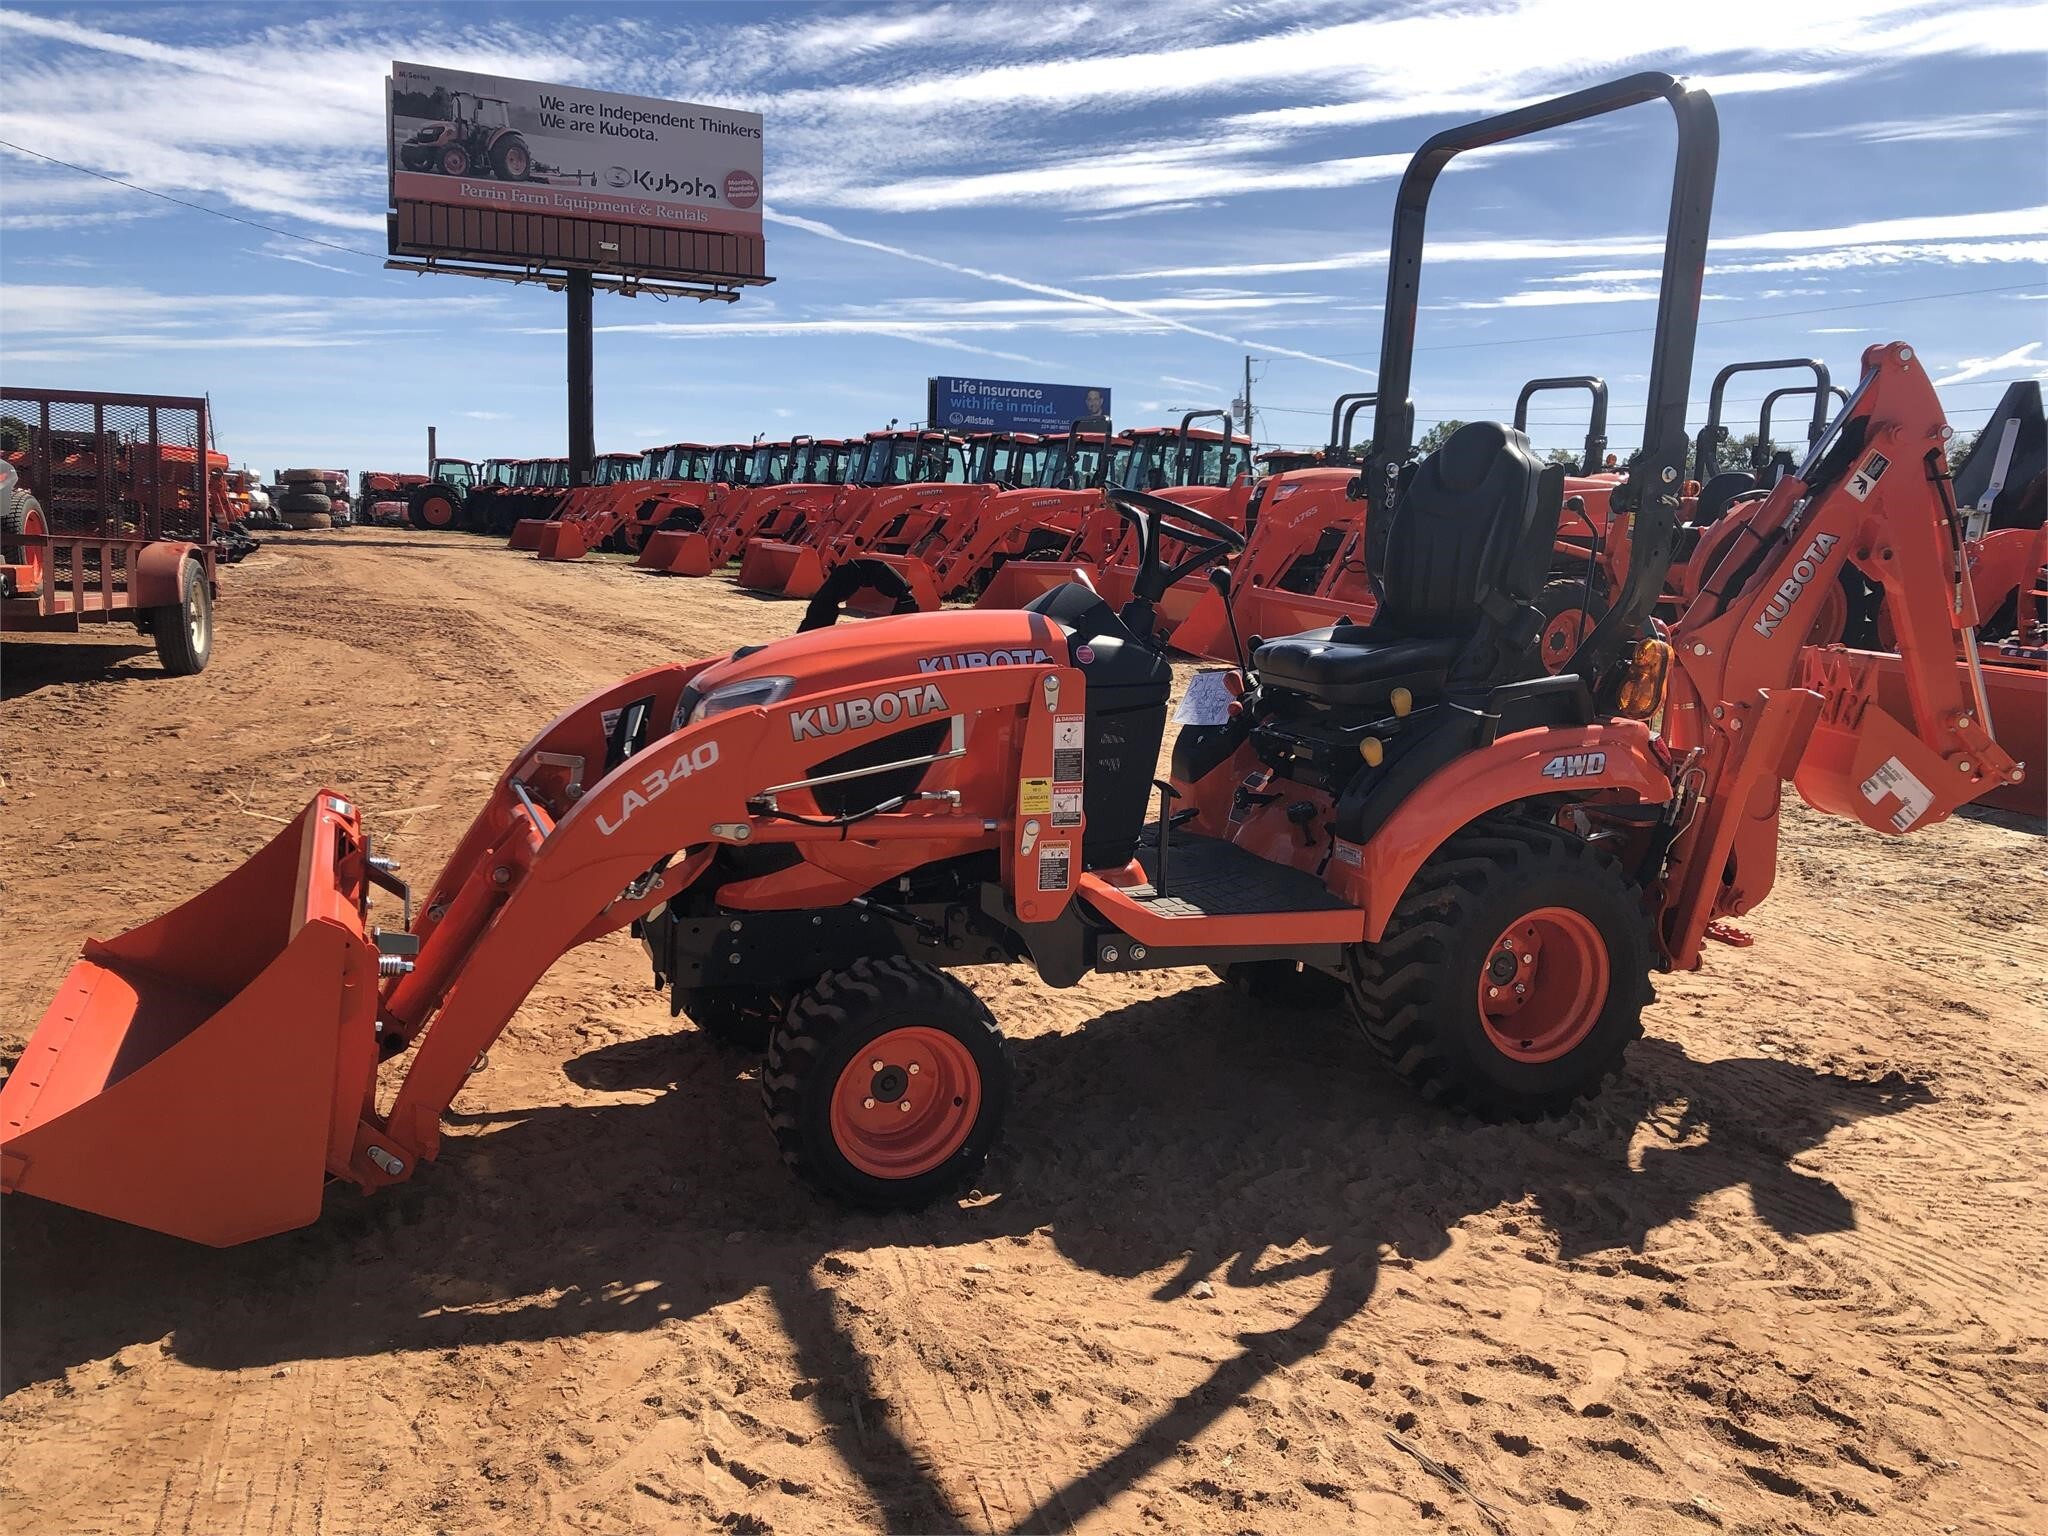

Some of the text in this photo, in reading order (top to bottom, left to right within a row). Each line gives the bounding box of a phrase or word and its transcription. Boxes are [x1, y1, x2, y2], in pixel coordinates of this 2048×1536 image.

[539, 95, 761, 139] We are Independent Thinkers
[539, 113, 659, 142] We are Kubota.
[634, 169, 717, 199] Kubota
[460, 183, 709, 223] Perrin Farm Equipment & Rentals
[950, 379, 1043, 399] Life insurance
[950, 396, 1057, 415] with life in mind.
[963, 415, 995, 426] Allstate
[1031, 499, 1062, 508] KUBOTA
[1288, 505, 1318, 529] LA765
[1752, 532, 1840, 639] KUBOTA
[918, 649, 1051, 674] KUBOTA
[789, 683, 949, 742] KUBOTA
[1542, 753, 1606, 779] 4WD
[594, 740, 720, 837] LA340
